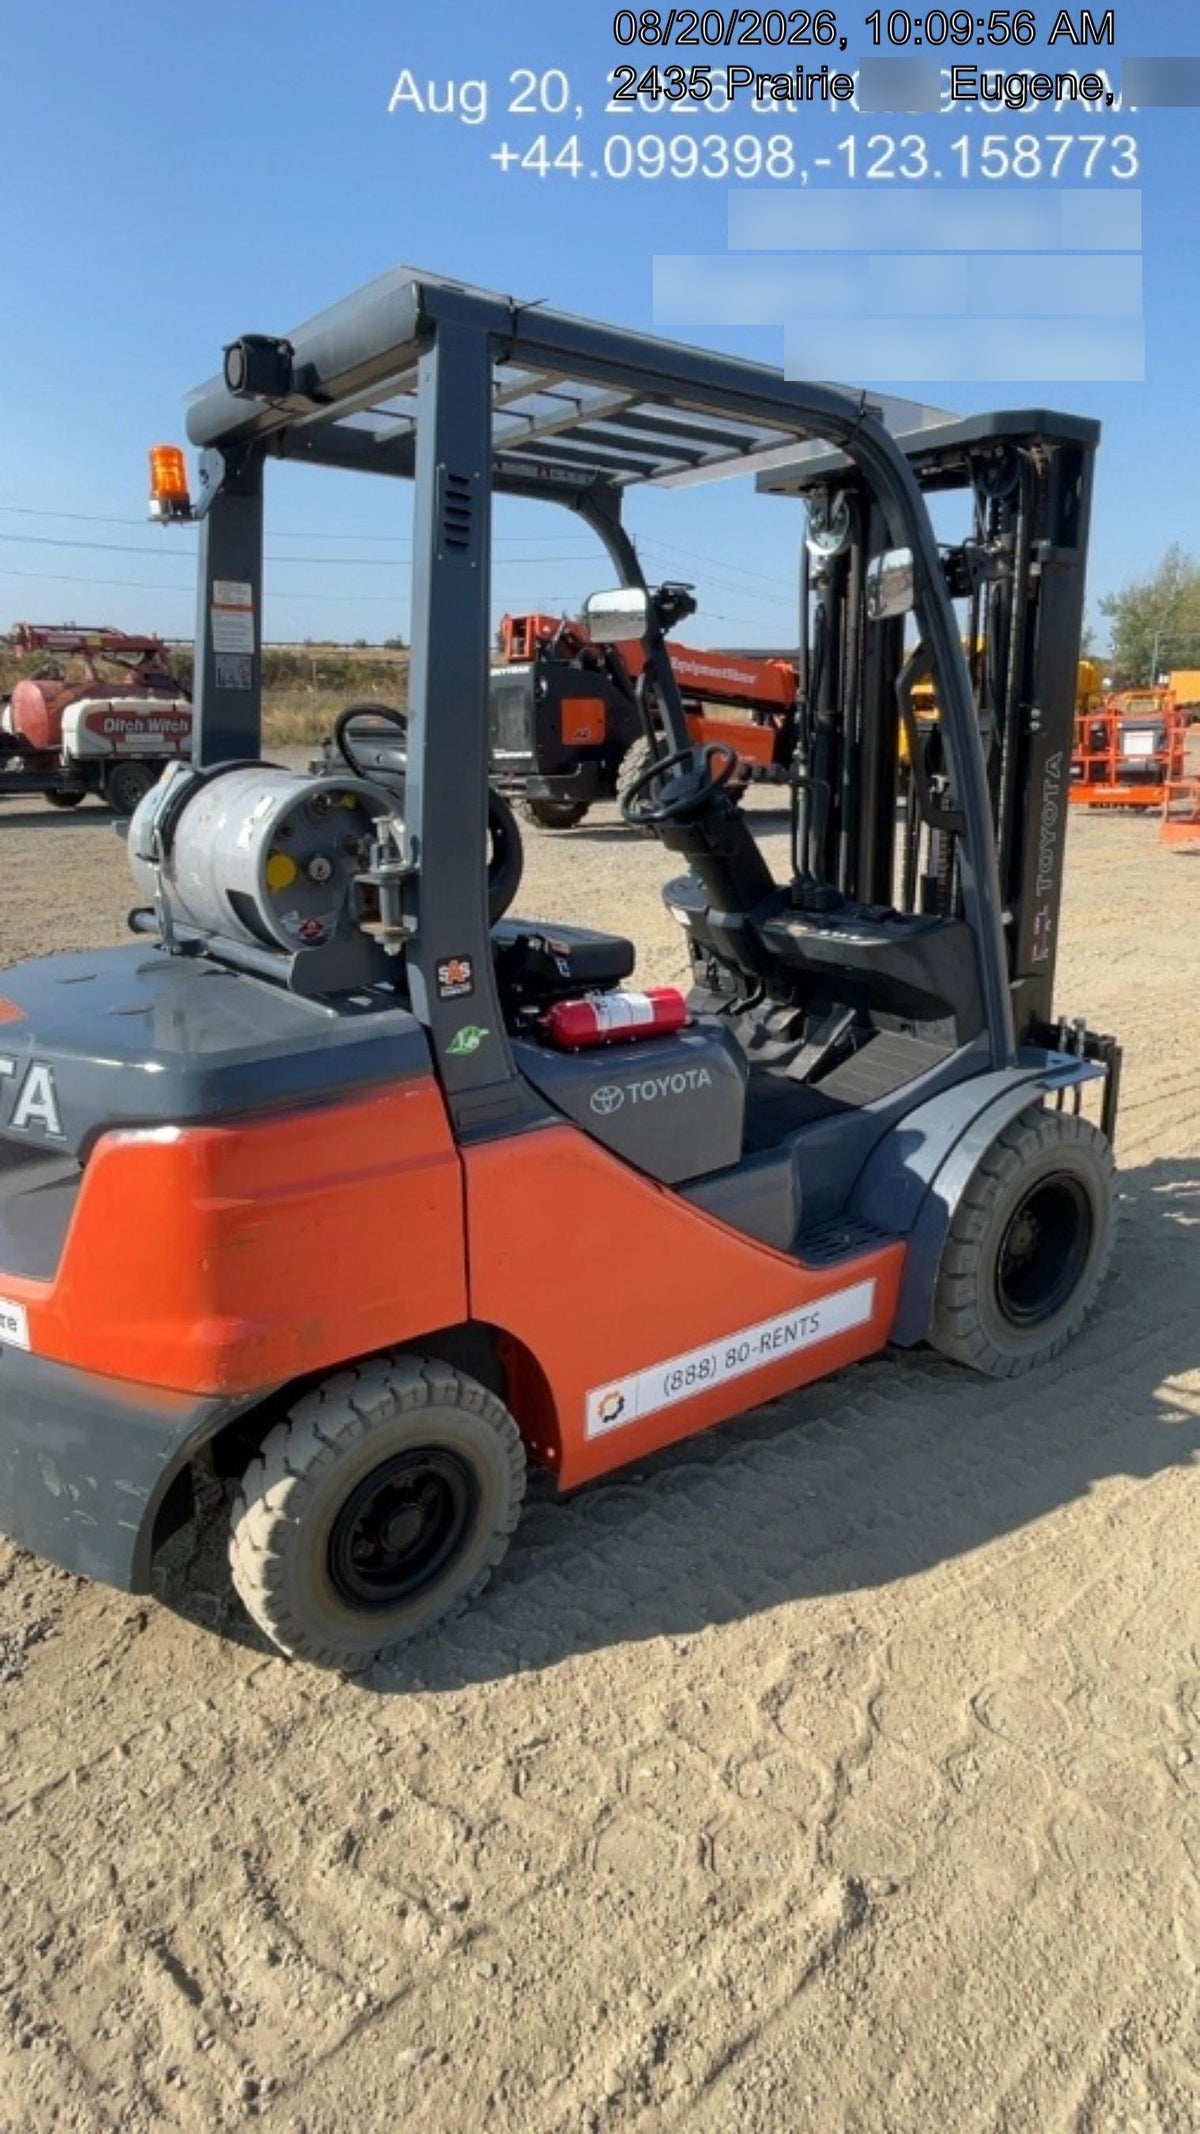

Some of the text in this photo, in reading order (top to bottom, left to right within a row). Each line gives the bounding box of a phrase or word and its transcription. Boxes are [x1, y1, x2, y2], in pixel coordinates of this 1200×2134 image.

[104, 717, 188, 734] Ditch Witch
[1035, 751, 1064, 898] TOYOTA
[626, 1068, 712, 1104] TOYOTA
[662, 1311, 821, 1398] (888) 80-RENTS
